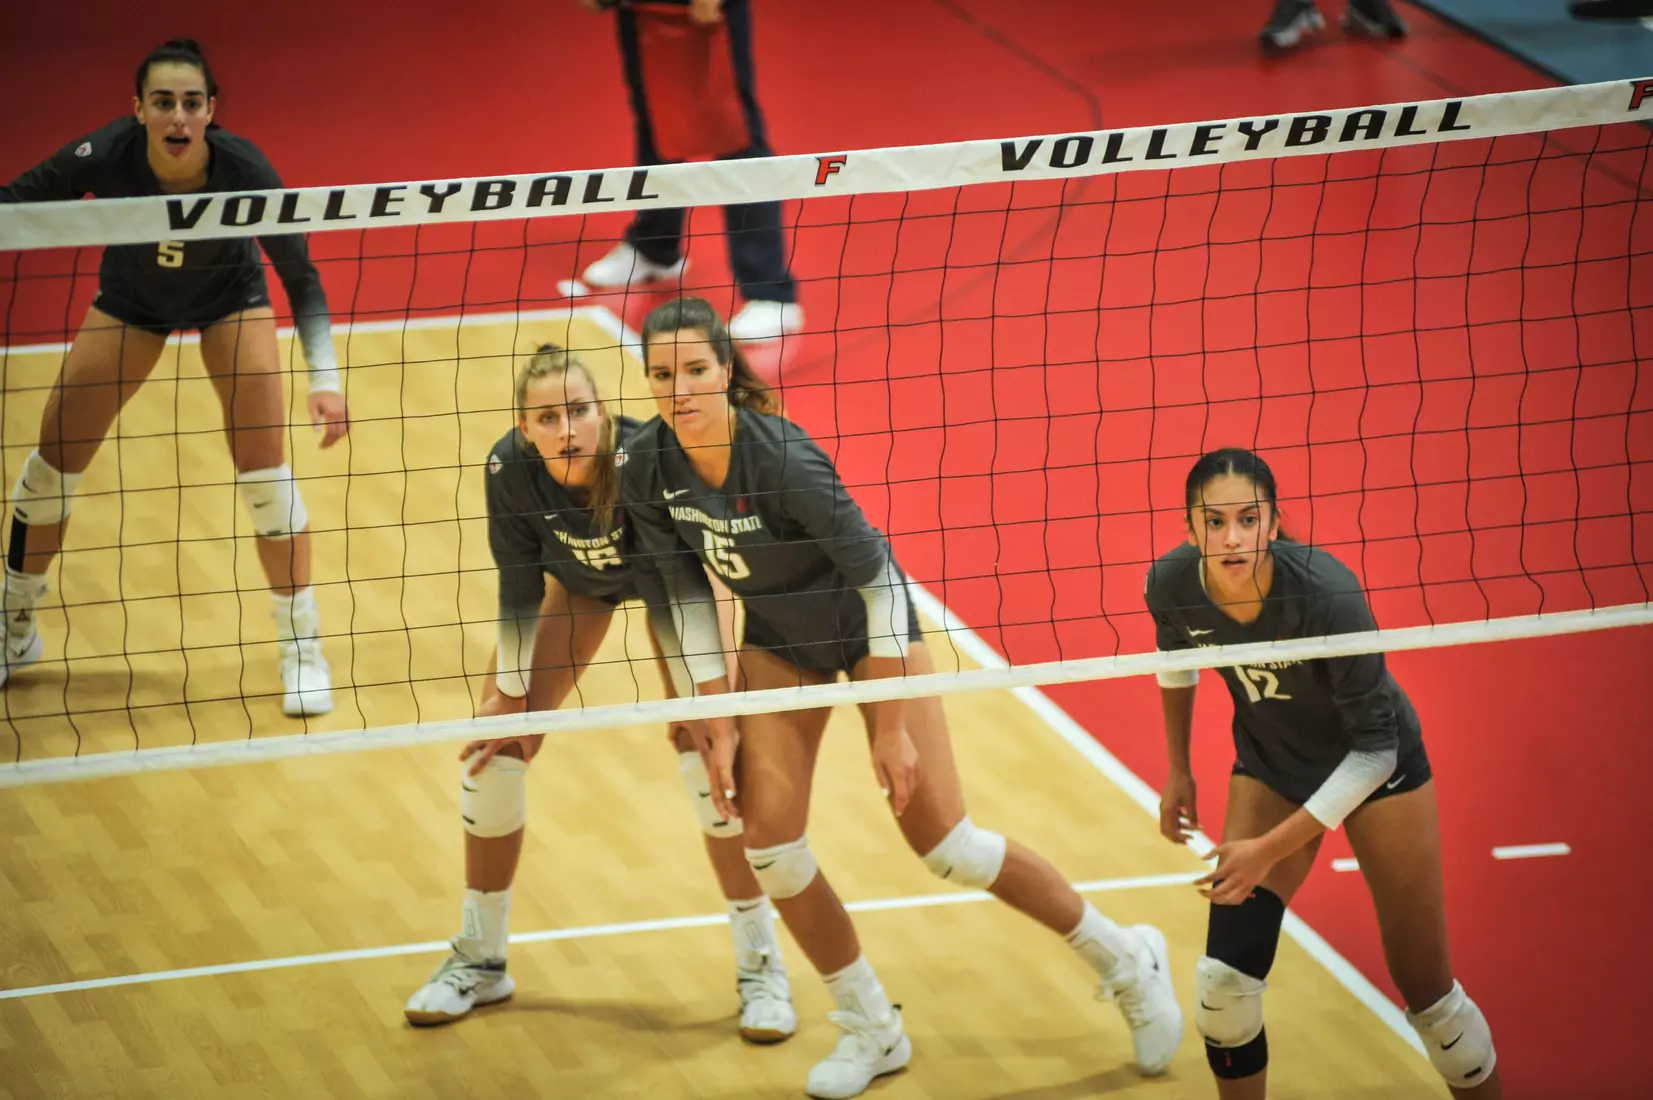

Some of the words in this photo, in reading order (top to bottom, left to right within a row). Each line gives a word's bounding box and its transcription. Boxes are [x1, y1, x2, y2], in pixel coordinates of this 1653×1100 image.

[166, 169, 659, 230] VOLLEYBALL
[814, 154, 848, 187] F
[1000, 101, 1471, 171] VOLLEYBALL
[1627, 80, 1653, 112] F
[157, 240, 186, 268] 5
[668, 505, 729, 533] WASHITON
[701, 530, 751, 580] 15
[1233, 665, 1293, 703] 12
